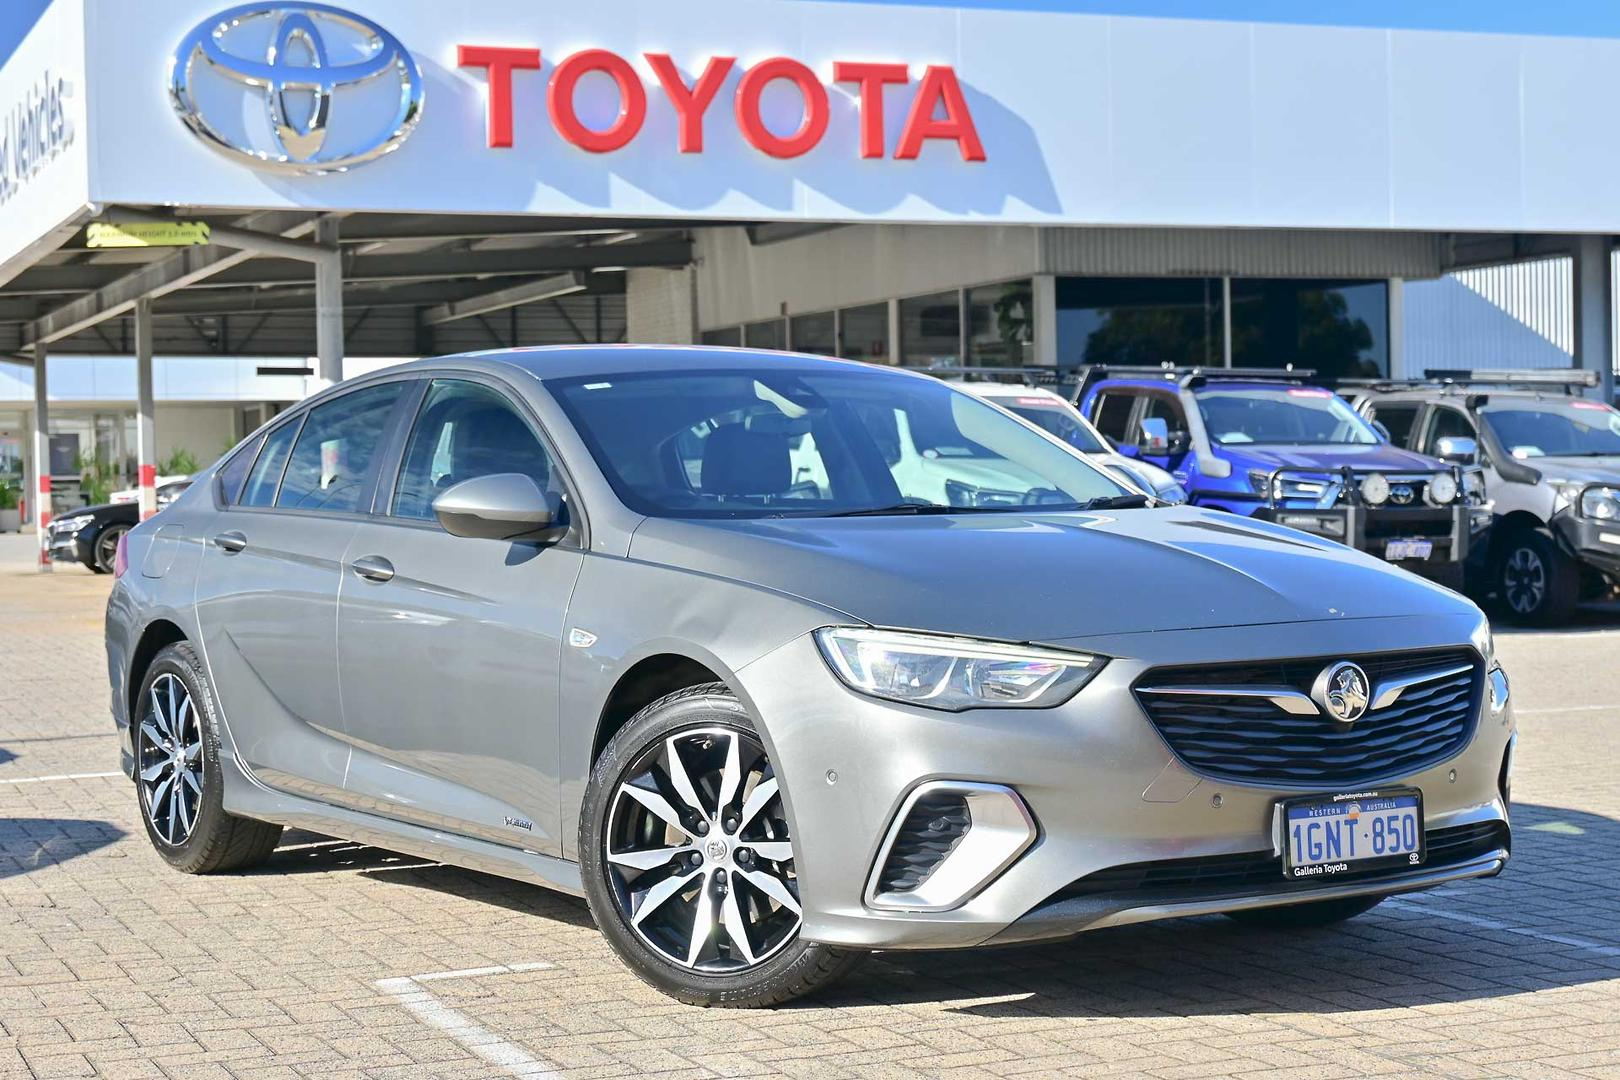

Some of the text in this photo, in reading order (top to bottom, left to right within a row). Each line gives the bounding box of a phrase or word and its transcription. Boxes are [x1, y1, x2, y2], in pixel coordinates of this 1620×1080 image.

[12, 69, 64, 180] Vehicles
[457, 45, 987, 162] TOYOTA
[1309, 802, 1397, 817] WESTERN AUSTRALIA
[1294, 863, 1348, 877] Galleria Toyota
